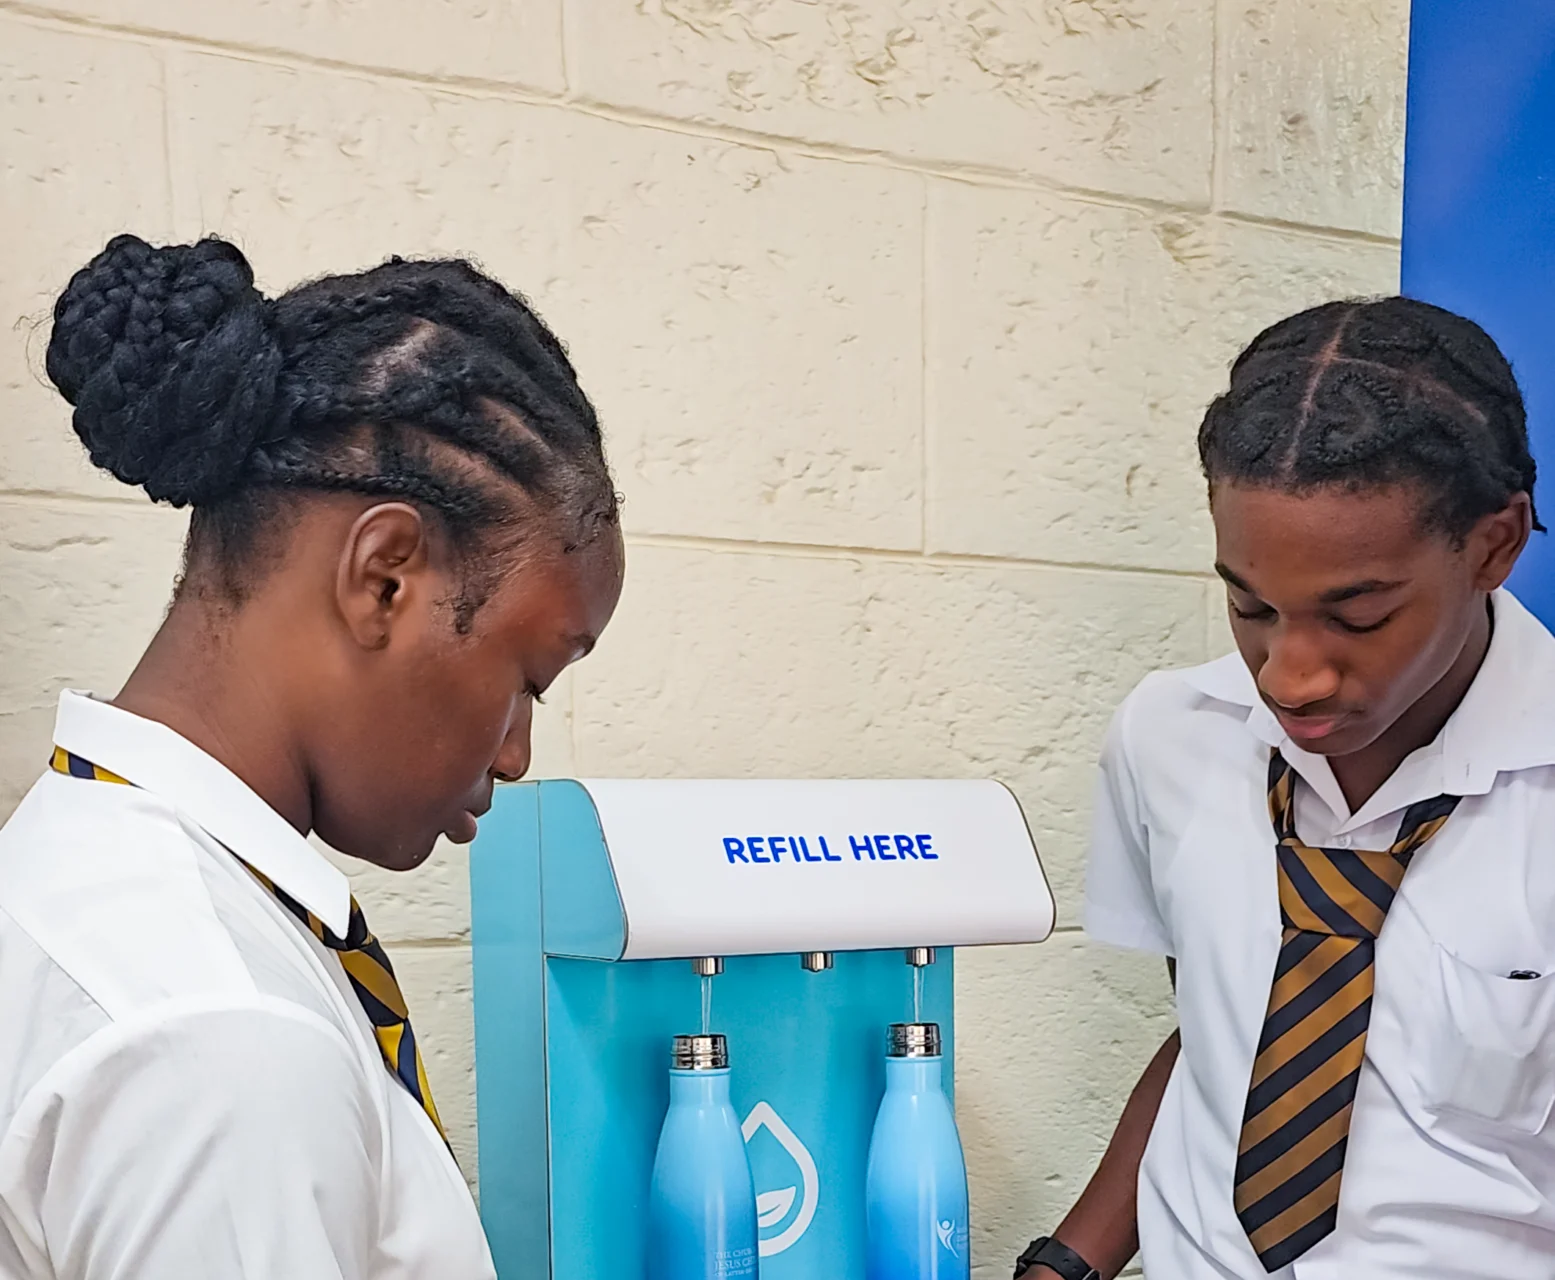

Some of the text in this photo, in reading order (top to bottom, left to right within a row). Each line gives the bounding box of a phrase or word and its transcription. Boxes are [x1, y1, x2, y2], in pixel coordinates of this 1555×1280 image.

[722, 834, 939, 864] REFILL HERE
[713, 1259, 741, 1271] JESUS
